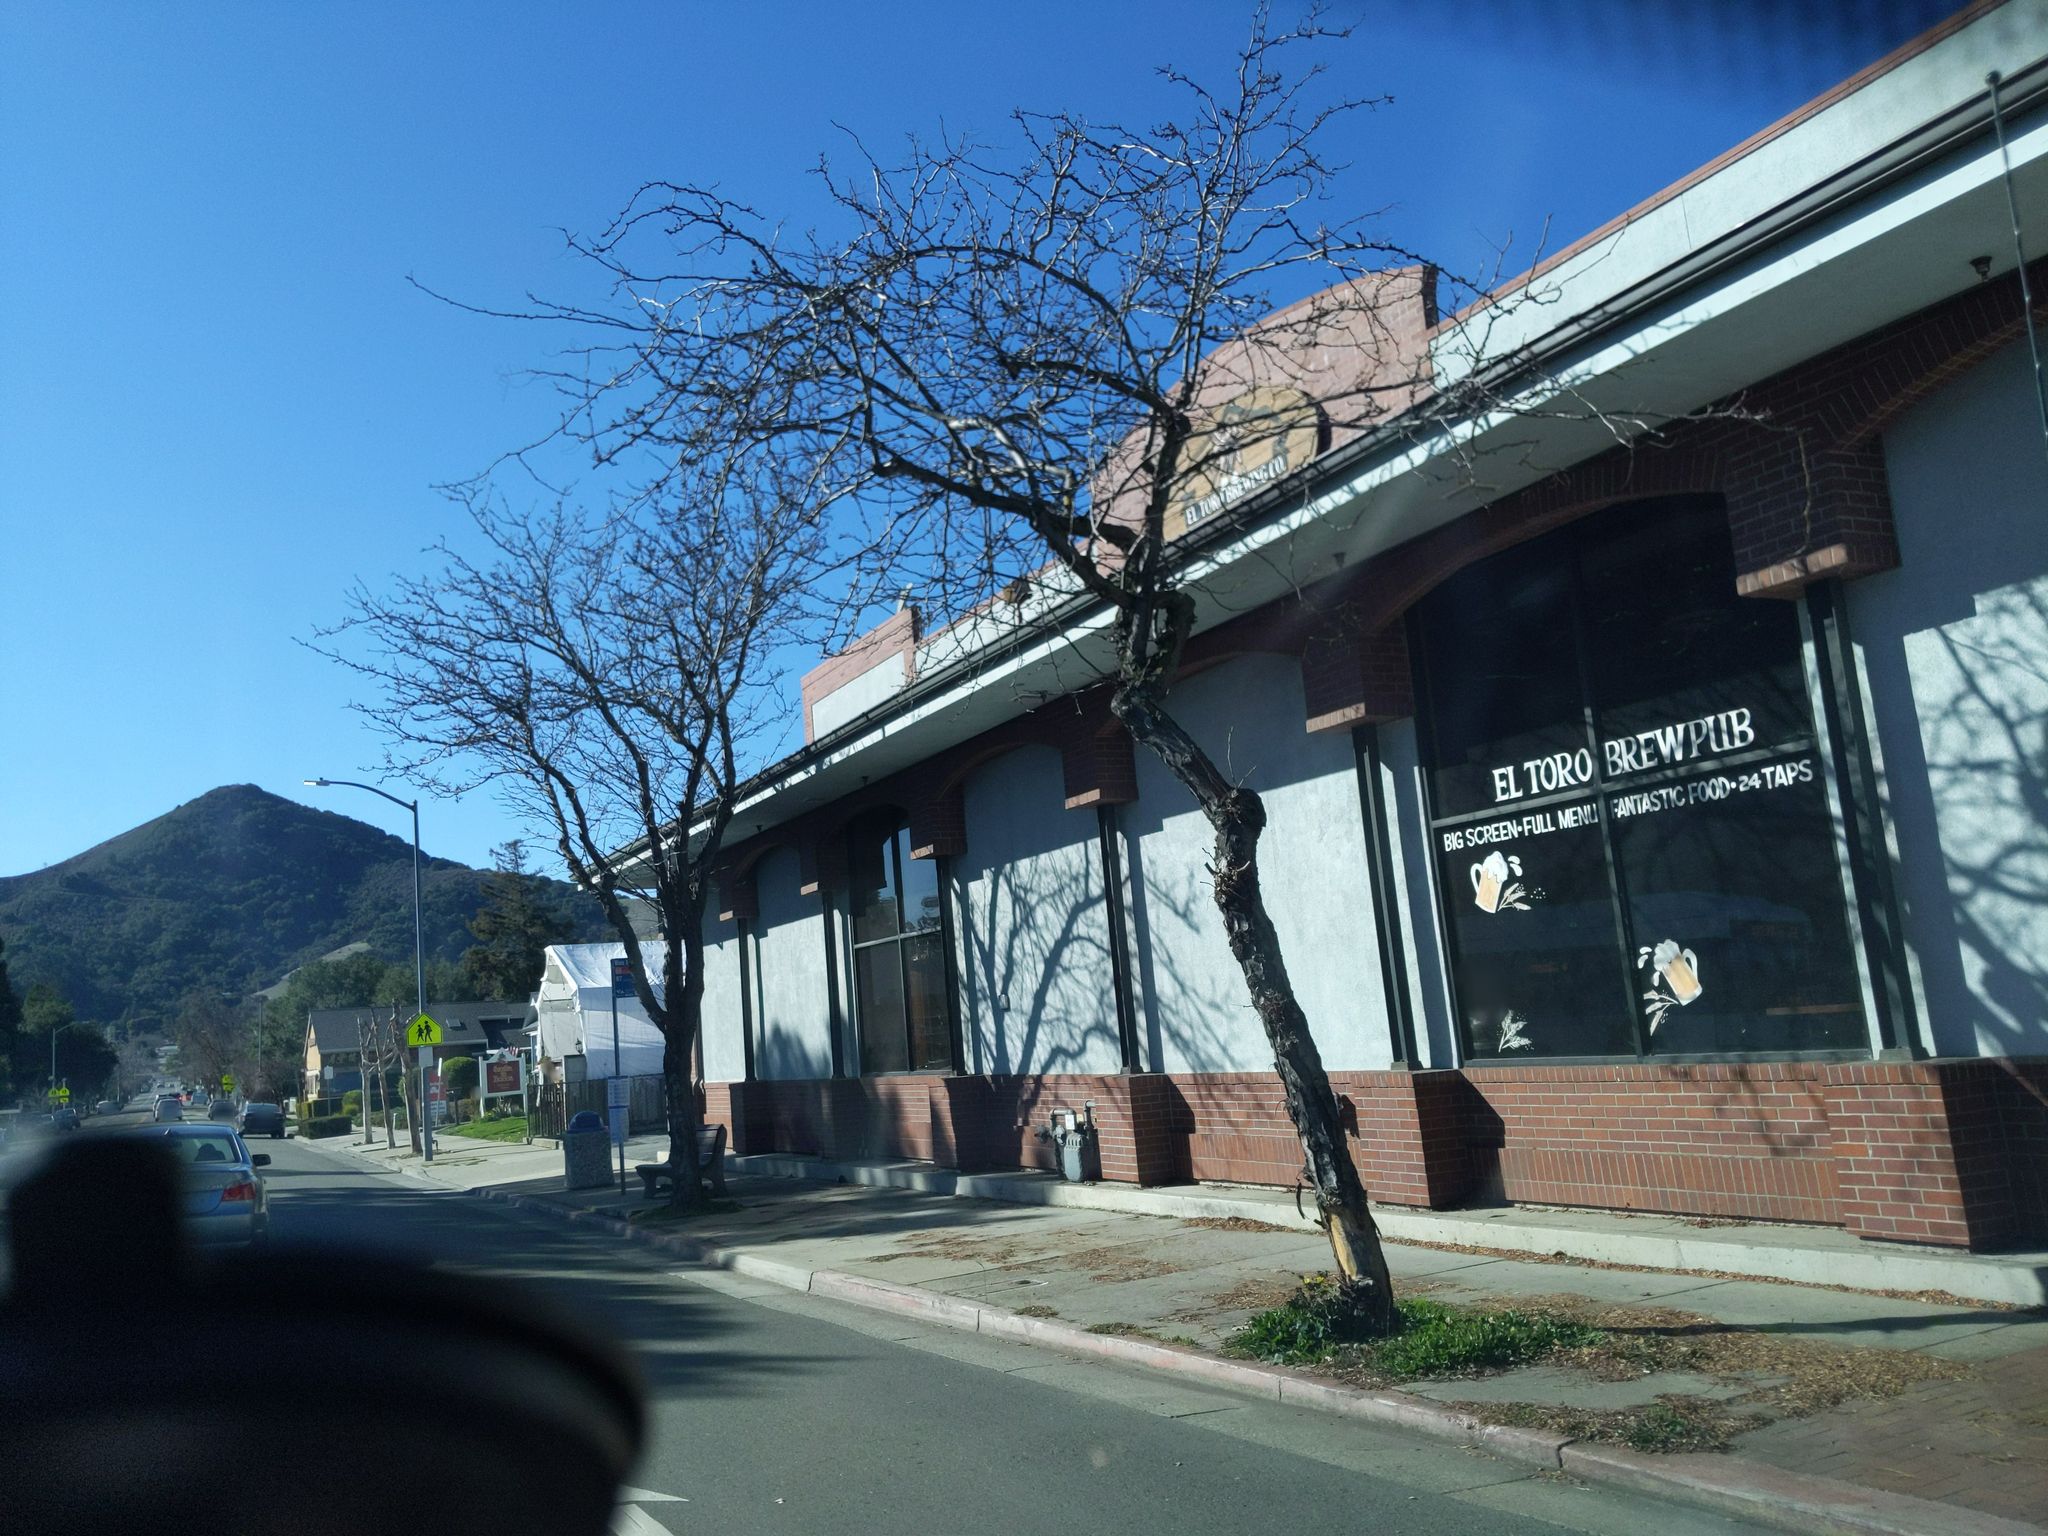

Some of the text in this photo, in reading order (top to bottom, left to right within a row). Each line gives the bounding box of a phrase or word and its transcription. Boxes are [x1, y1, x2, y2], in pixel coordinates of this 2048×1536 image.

[1492, 708, 1755, 802] EL TORO BREWPUB
[1443, 832, 1464, 852] BIG
[1557, 803, 1599, 830] MENU
[1611, 786, 1685, 819] FANTASTIC
[1687, 776, 1732, 805] FOOD
[1738, 774, 1762, 792] 24
[1761, 759, 1814, 790] TAPS
